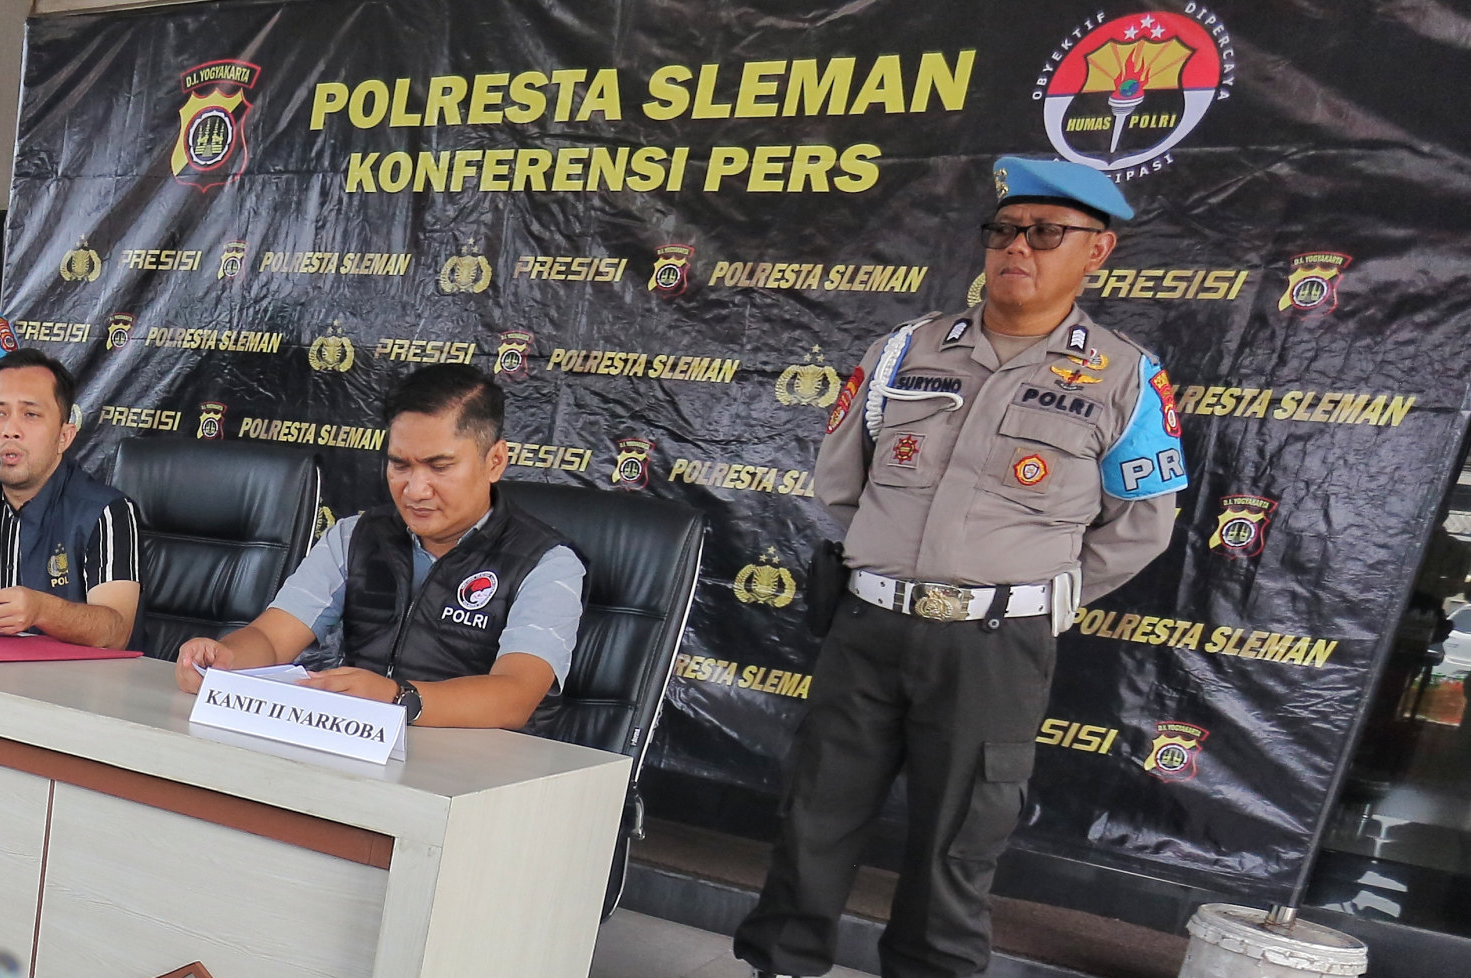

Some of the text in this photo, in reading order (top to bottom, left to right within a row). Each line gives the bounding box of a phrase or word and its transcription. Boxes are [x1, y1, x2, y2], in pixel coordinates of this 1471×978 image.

[1032, 12, 1106, 100] OBYEKTIF
[1185, 2, 1235, 100] DIPERCAYA
[186, 65, 250, 88] D.I. YOGYAKARTA
[310, 50, 976, 130] POLRESTA SLEMAN
[1066, 114, 1177, 131] HUMAS POLRI
[345, 144, 881, 193] KONFERENSI PERS
[1106, 153, 1174, 184] IPASI
[118, 250, 202, 271] PRESISI
[259, 251, 412, 276] POLRESTA SLEMAN
[513, 256, 628, 282] PRESISI
[708, 261, 928, 293] POLRESTA SLEMAN
[1076, 269, 1249, 300] PRESISI
[14, 320, 90, 343] PRESISI
[145, 327, 283, 354] POLRESTA SLEMAN
[374, 338, 477, 364] PRESISI
[546, 348, 740, 383] POLRESTA SLEMAN
[897, 376, 963, 392] SURYONO
[99, 405, 181, 431] PRESISI
[1021, 388, 1096, 418] POLRI
[1273, 391, 1416, 427] SLEMAN
[238, 417, 386, 450] POLRESTA SLEMAN
[668, 458, 779, 493] POLRESTA
[441, 606, 489, 630] POLRI
[1073, 607, 1339, 668] POLRESTA SLEMAN
[738, 665, 813, 699] SLEMA
[205, 688, 386, 744] KANIT II NARKOBA
